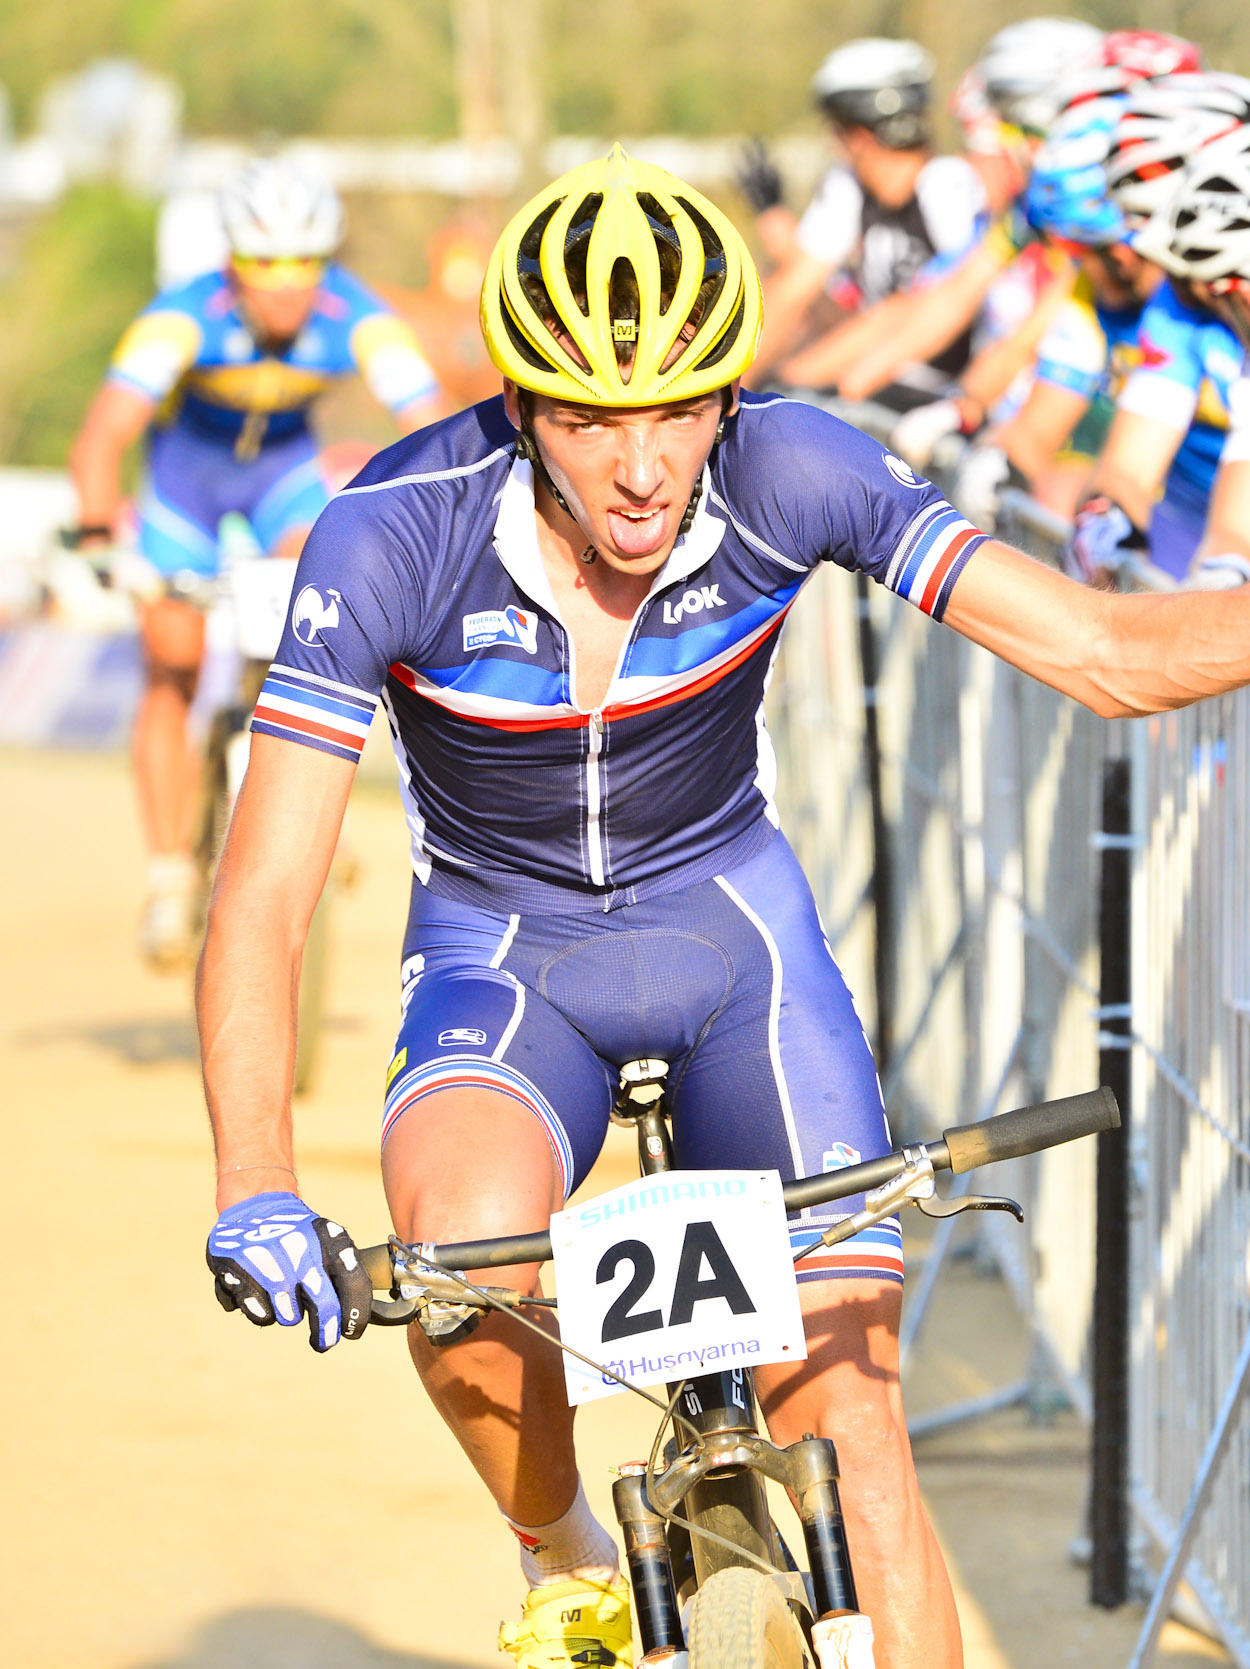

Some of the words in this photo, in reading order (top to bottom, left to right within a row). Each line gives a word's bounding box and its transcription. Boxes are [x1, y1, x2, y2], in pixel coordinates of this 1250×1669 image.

[579, 1179, 748, 1229] SHIMANO
[596, 1220, 757, 1344] 2A
[629, 1339, 761, 1378] Husqvarna
